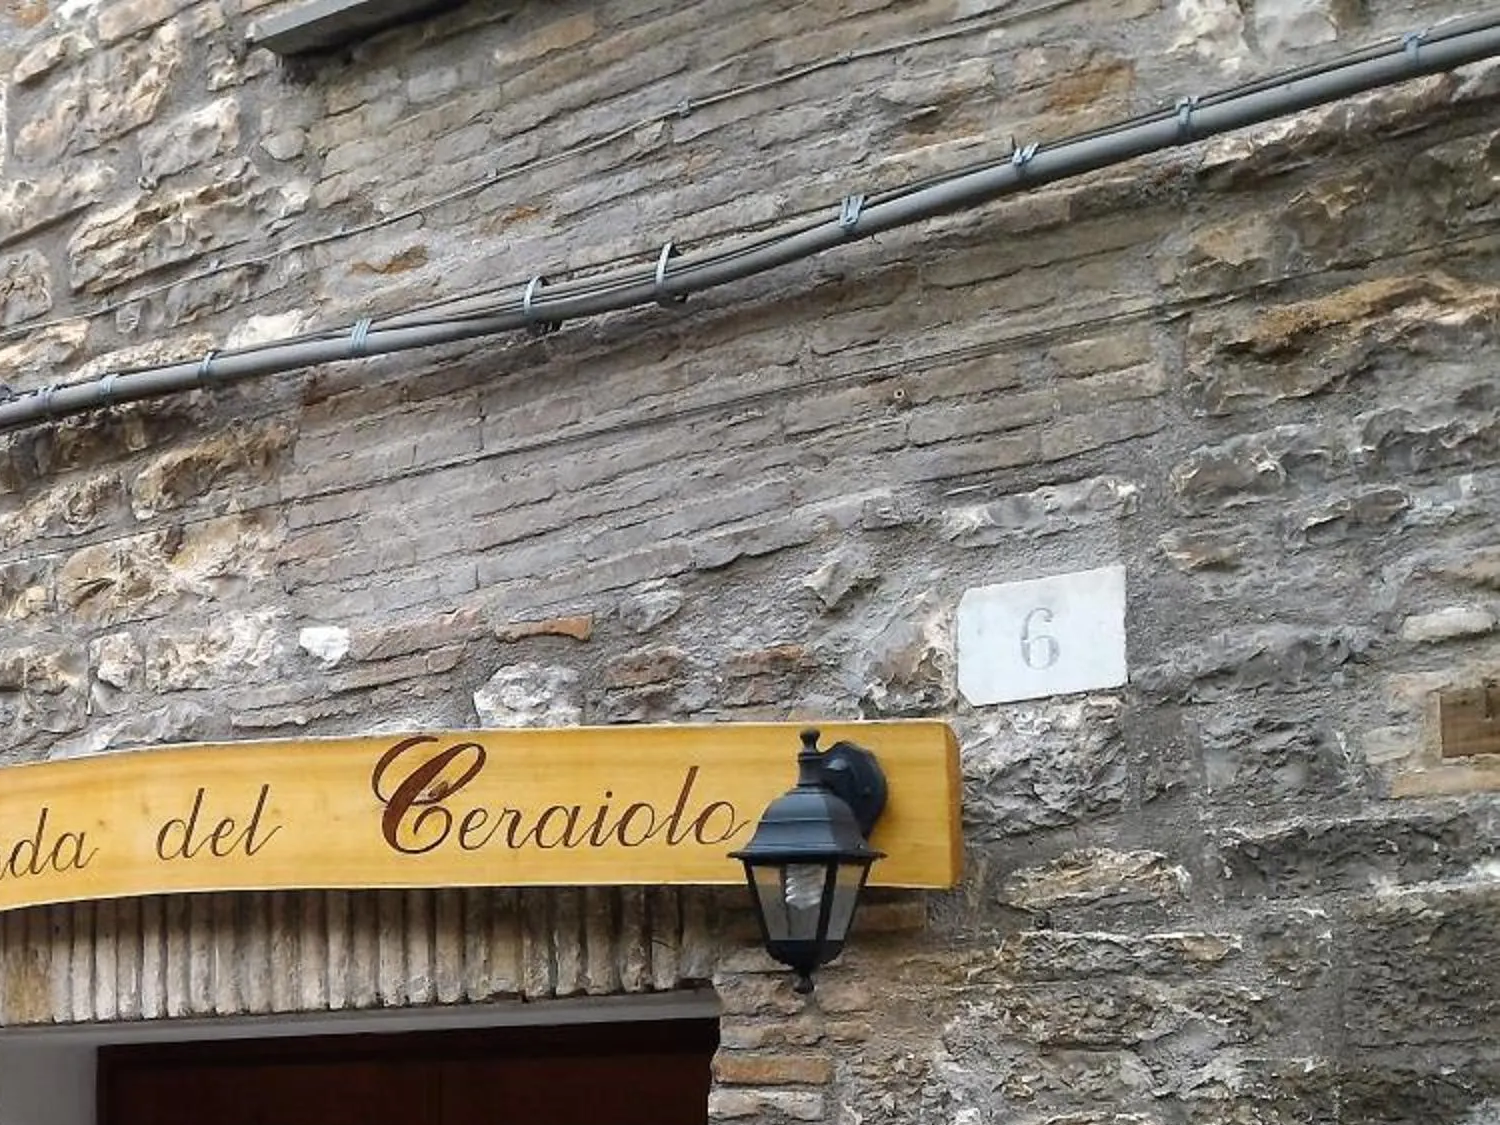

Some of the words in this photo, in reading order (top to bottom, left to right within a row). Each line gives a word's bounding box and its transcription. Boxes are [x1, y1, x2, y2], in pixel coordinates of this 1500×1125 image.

[1019, 605, 1060, 671] 6
[155, 783, 285, 862] del
[372, 735, 748, 855] Ceraiolo
